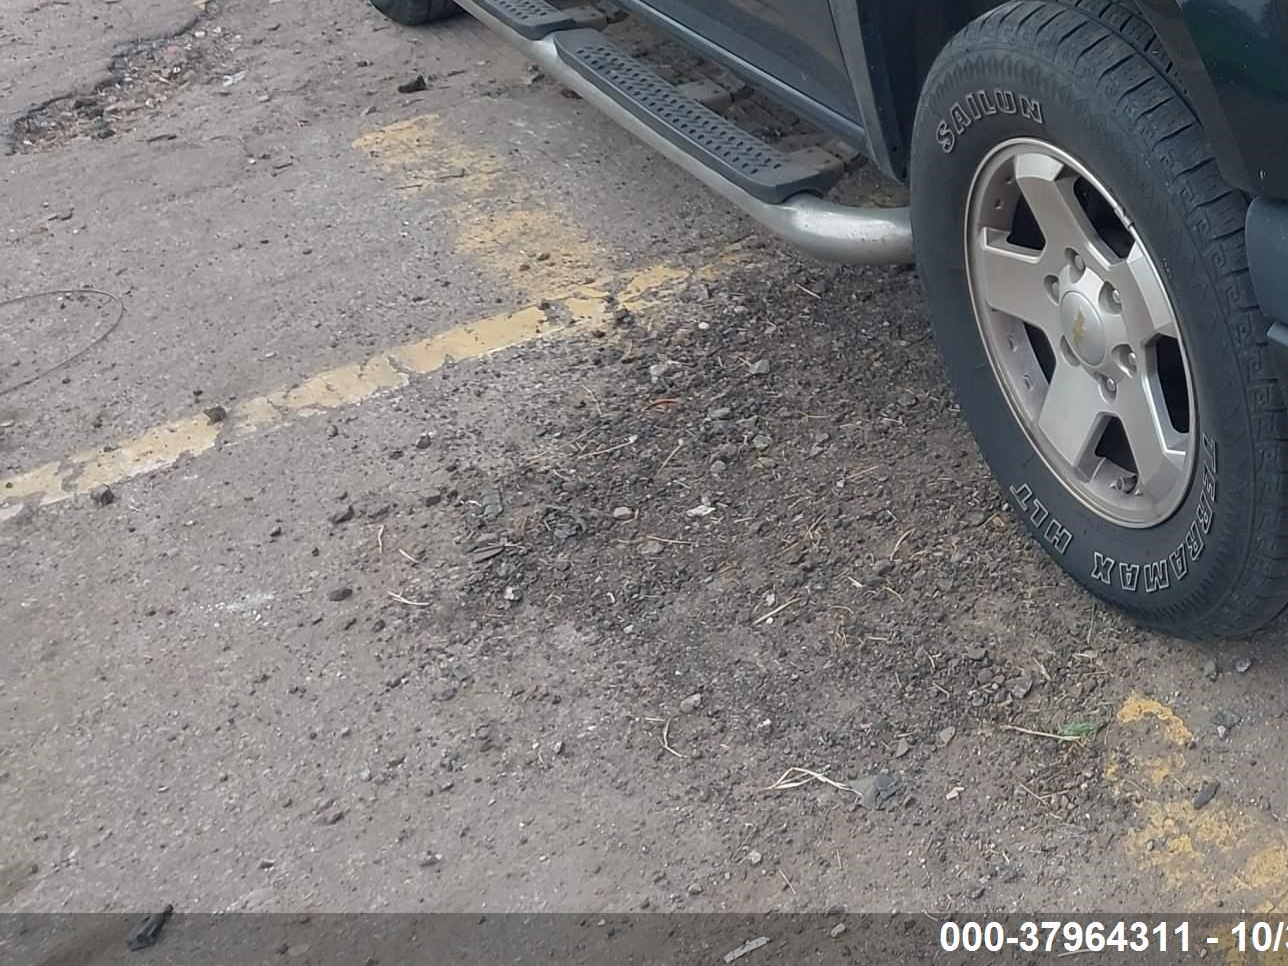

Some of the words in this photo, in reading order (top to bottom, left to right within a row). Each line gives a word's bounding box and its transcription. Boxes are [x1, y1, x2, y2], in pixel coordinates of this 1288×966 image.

[936, 90, 1043, 153] SAILUN
[1009, 483, 1073, 554] HLT
[1091, 433, 1217, 593] TERRAMAX
